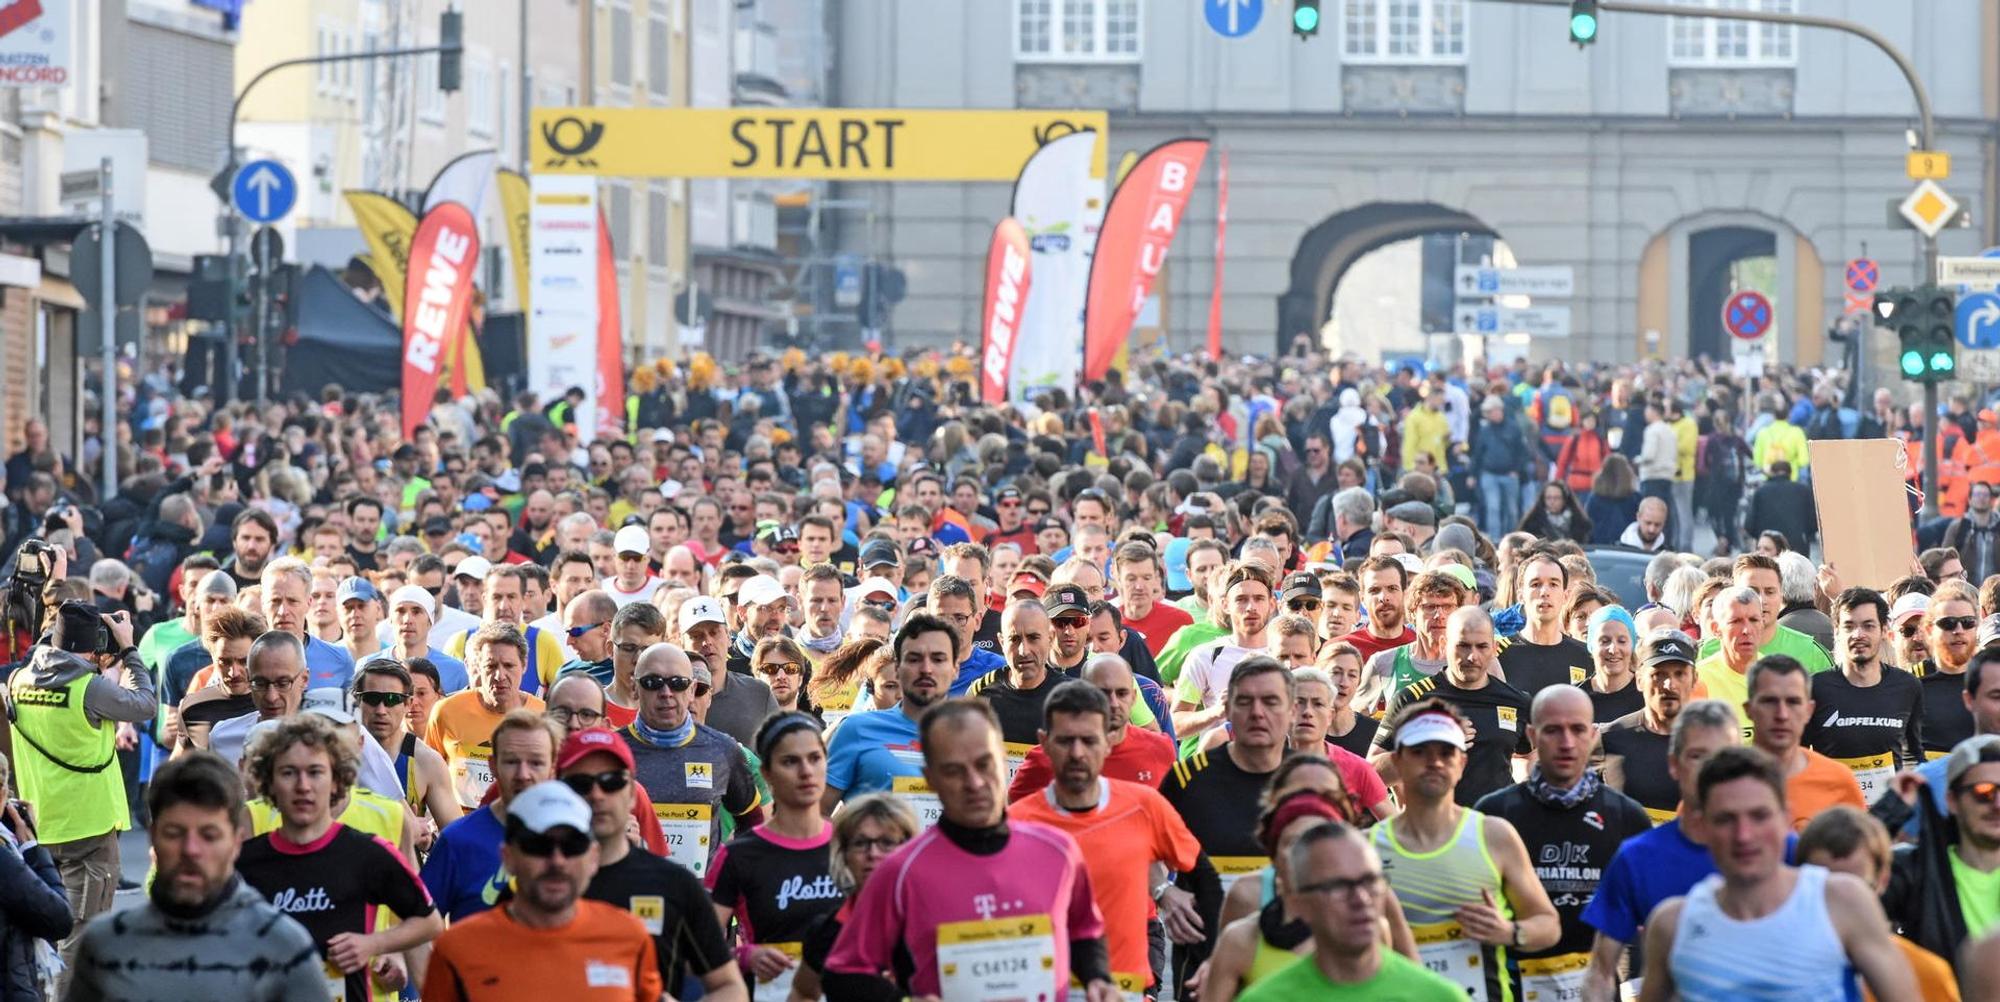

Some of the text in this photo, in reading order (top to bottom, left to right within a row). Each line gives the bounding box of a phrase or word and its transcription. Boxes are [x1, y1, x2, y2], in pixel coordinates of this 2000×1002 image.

[731, 118, 905, 168] START
[1924, 156, 1933, 174] 9
[406, 225, 470, 375] REWE
[984, 243, 1026, 387] REWE
[1835, 717, 1904, 728] GIPFELKURS
[671, 810, 684, 818] Post
[1541, 841, 1591, 867] DJK
[1537, 867, 1601, 879] RIATHLON
[775, 875, 843, 910] flott.
[971, 956, 1029, 976] C14124
